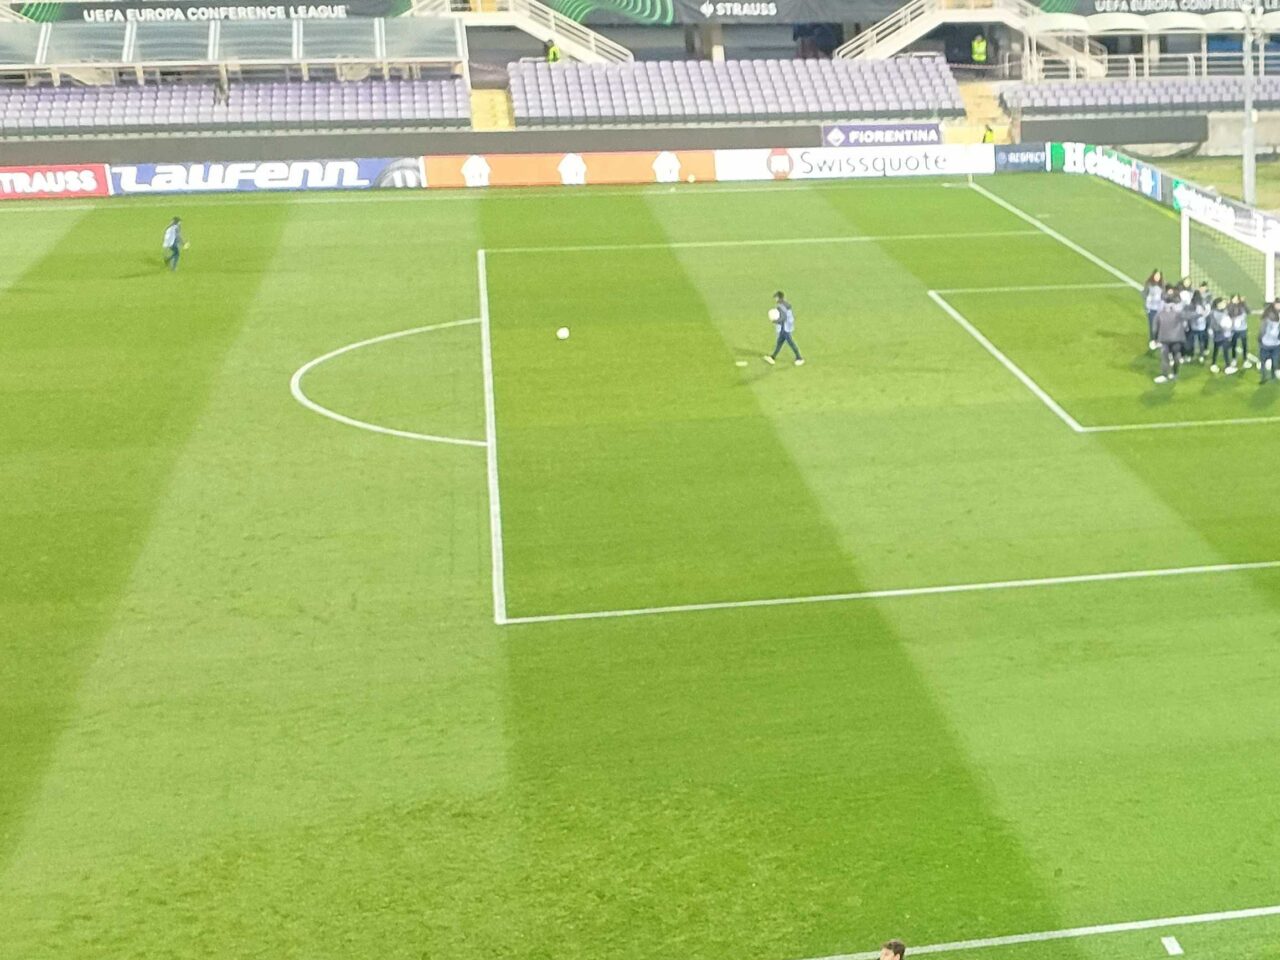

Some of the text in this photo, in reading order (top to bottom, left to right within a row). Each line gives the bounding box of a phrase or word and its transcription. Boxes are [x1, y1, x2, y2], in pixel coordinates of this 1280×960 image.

[83, 5, 347, 22] UEFA EUROPA CONFERENCE LEAGUE
[715, 2, 777, 16] STRAUSS
[849, 128, 938, 144] FIORENTINA
[800, 151, 947, 177] Swissquote
[111, 160, 371, 191] Laufenn
